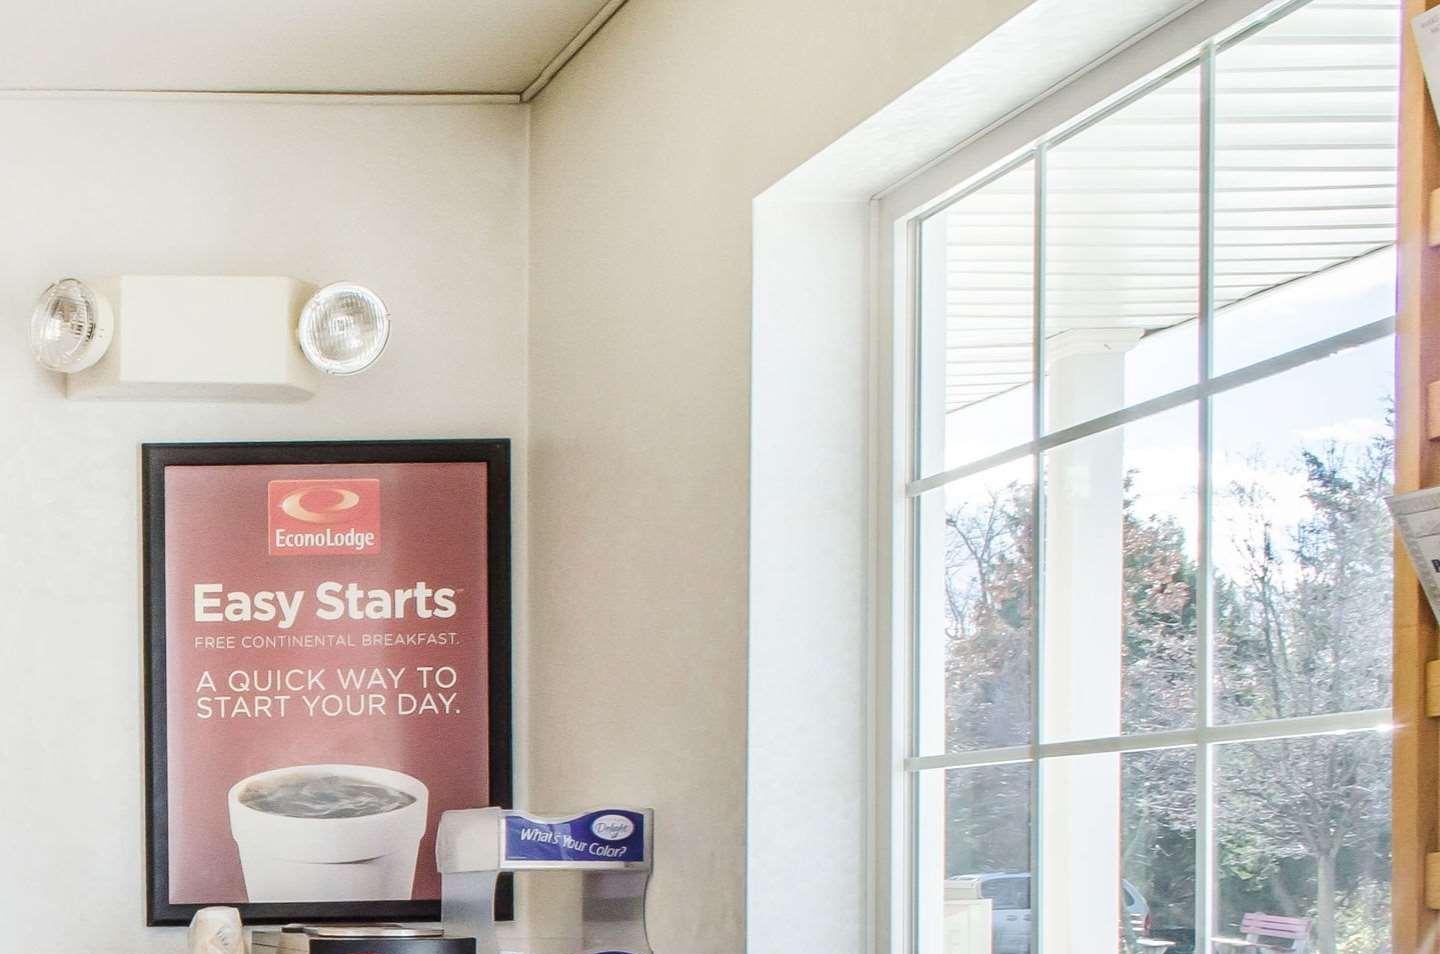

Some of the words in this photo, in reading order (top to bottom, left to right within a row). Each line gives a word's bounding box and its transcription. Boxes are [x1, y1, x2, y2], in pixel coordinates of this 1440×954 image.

[275, 528, 375, 551] EconoLodge
[193, 583, 305, 629] Easy
[315, 581, 457, 621] Starts
[194, 636, 235, 650] FREE
[241, 634, 355, 649] CONTINENTAL
[195, 671, 217, 693] A
[228, 668, 326, 693] QUICK
[336, 667, 407, 690] WAY
[416, 666, 458, 689] TO
[196, 695, 291, 719] START
[302, 694, 387, 718] YOUR
[397, 692, 461, 716] DAY.
[562, 834, 588, 852] Your
[589, 842, 627, 857] Color?
